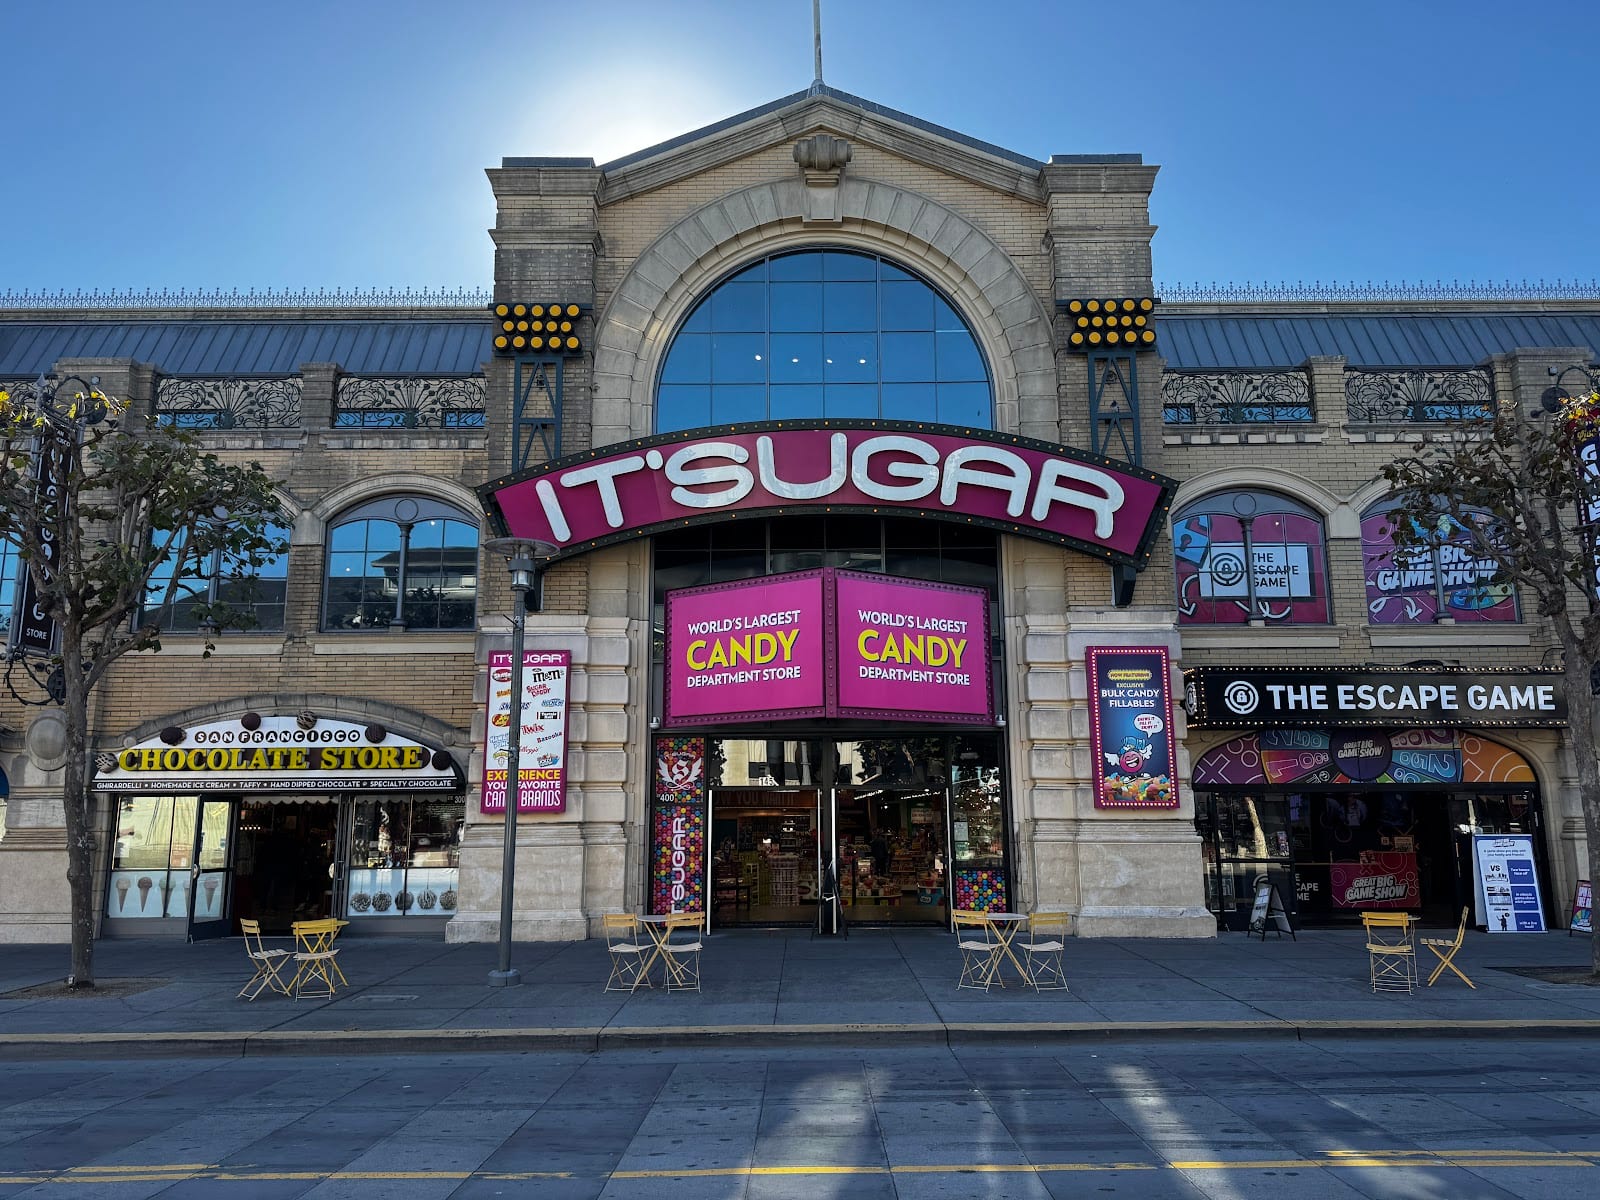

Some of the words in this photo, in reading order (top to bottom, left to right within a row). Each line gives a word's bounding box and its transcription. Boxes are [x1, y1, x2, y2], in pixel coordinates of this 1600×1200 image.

[535, 432, 1125, 542] IT'SUGAR
[1252, 565, 1299, 575] ESCAPE
[1253, 577, 1287, 588] GAME
[688, 612, 742, 635] WORLD'S
[744, 610, 801, 629] LARGEST
[858, 609, 914, 628] WORLD'S
[916, 617, 967, 634] LARGEST
[26, 627, 48, 640] STORE
[686, 629, 800, 671] CANDY
[857, 629, 968, 668] CANDY
[687, 669, 760, 688] DEPARTMENT
[763, 665, 801, 682] STORE
[859, 665, 934, 684] DEPARTMENT
[936, 672, 970, 686] STORE
[1101, 689, 1125, 698] BULK
[1127, 689, 1160, 698] CANDY
[1266, 685, 1328, 710] THE
[1337, 685, 1458, 710] ESCAPE
[1467, 685, 1556, 710] GAME
[1109, 699, 1155, 708] FILLABLES
[195, 732, 234, 742] SAN
[239, 731, 361, 743] FRANCISCO
[536, 731, 563, 743] Bazooka
[119, 747, 308, 771] CHOCOLATE
[320, 746, 423, 770] STORE
[486, 769, 561, 781] EXPRIENCE
[487, 781, 508, 791] YOU
[517, 780, 561, 789] FAVORITE
[454, 795, 466, 804] 300
[485, 790, 506, 807] CAN
[520, 789, 561, 807] BRANDS
[659, 794, 675, 802] 400
[671, 817, 687, 915] T'SUGAR
[1296, 882, 1318, 892] CAPE
[1354, 878, 1375, 888] GREAT
[1376, 875, 1394, 887] BIG
[1346, 887, 1375, 901] GAME
[1375, 884, 1408, 899] SHOW
